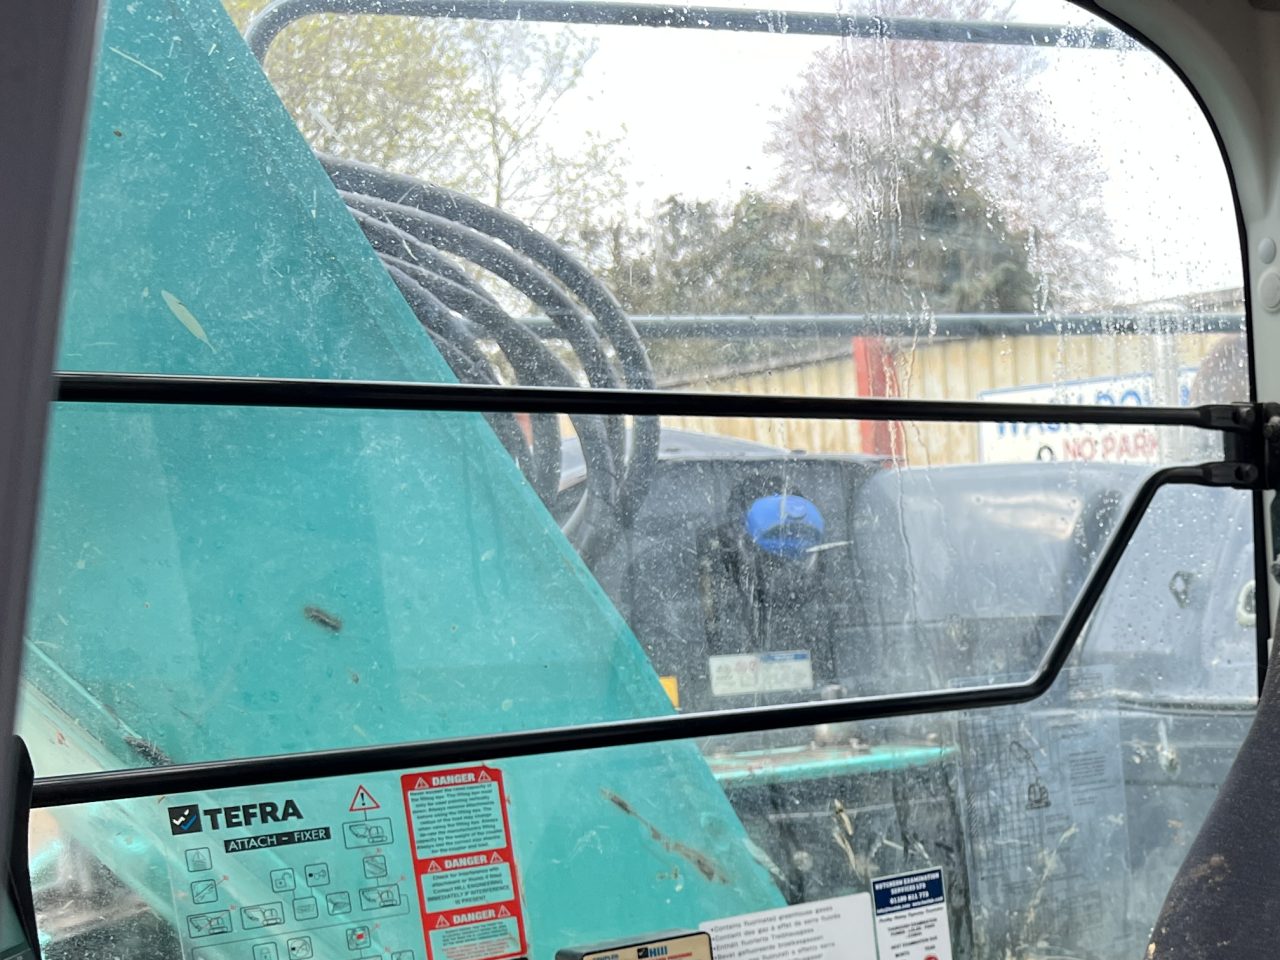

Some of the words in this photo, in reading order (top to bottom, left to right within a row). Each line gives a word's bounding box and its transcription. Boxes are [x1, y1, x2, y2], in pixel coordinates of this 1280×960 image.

[1062, 438, 1097, 460] NO
[432, 773, 475, 786] DANGER
[204, 800, 303, 830] TEFRA
[228, 832, 276, 851] ATTACH
[294, 829, 327, 842] FIXER
[444, 855, 487, 869] DANGER
[453, 909, 495, 924] DANGER
